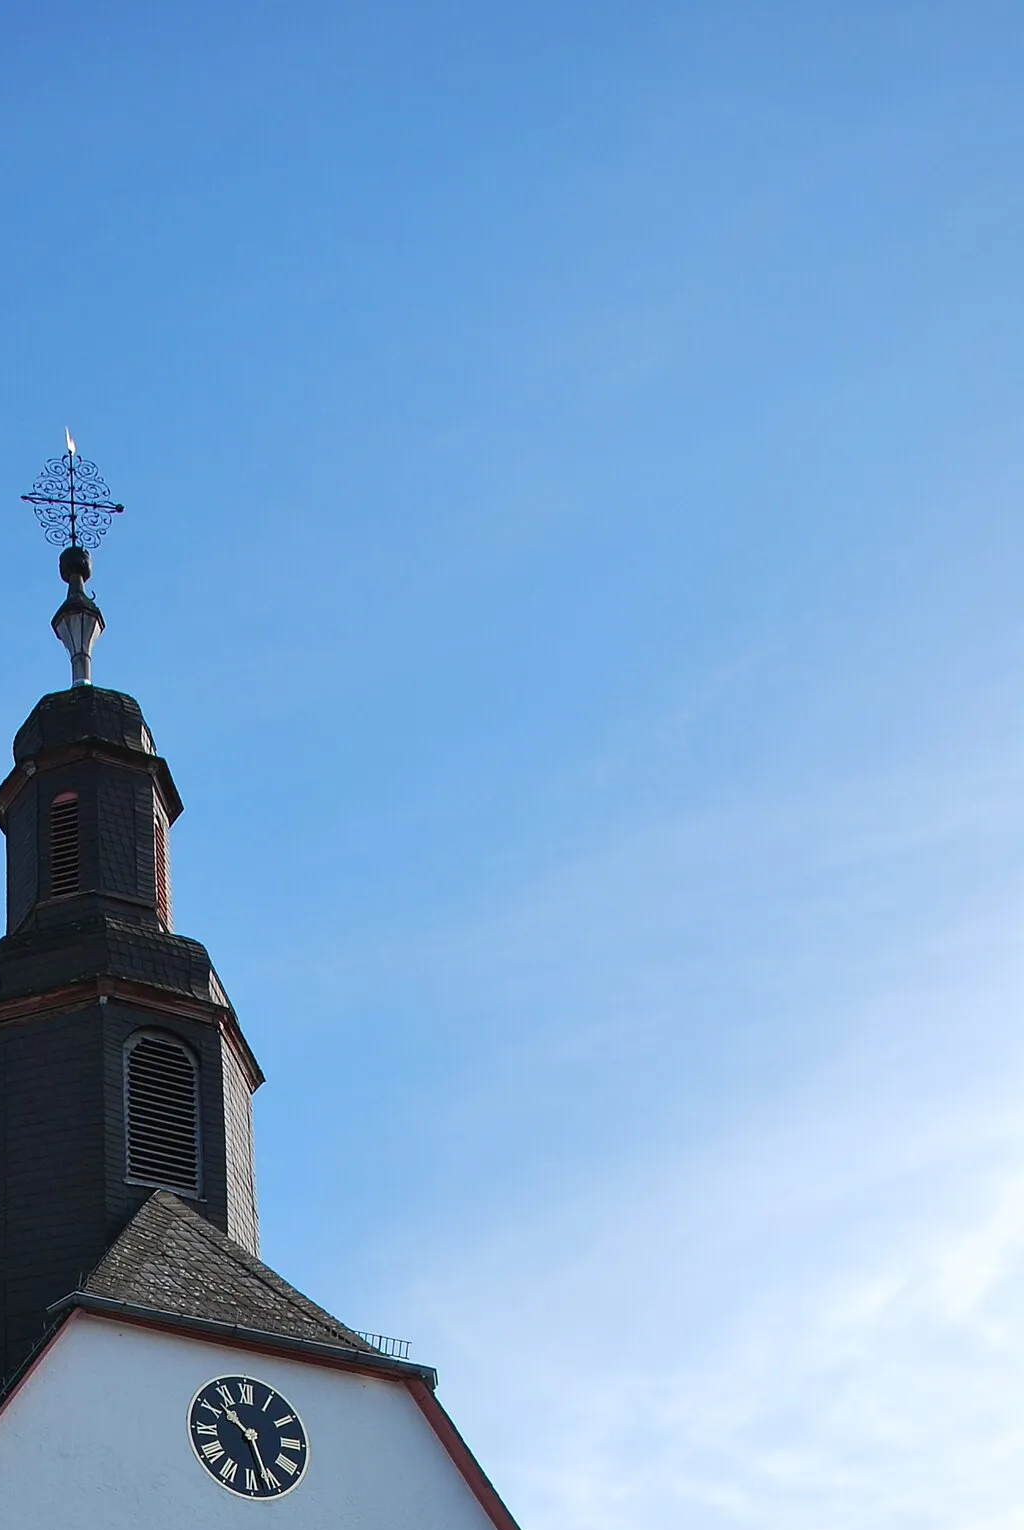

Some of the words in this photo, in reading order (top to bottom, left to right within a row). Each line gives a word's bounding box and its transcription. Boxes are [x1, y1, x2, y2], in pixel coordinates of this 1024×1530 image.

[216, 1385, 236, 1407] XI
[238, 1383, 254, 1405] XII
[262, 1395, 273, 1412] I
[201, 1399, 222, 1419] X
[197, 1421, 218, 1436] IX
[274, 1415, 293, 1428] II
[201, 1440, 225, 1464] VIII
[281, 1437, 300, 1450] III
[220, 1458, 238, 1482] VII
[275, 1454, 297, 1476] IIII
[246, 1468, 258, 1491] VI
